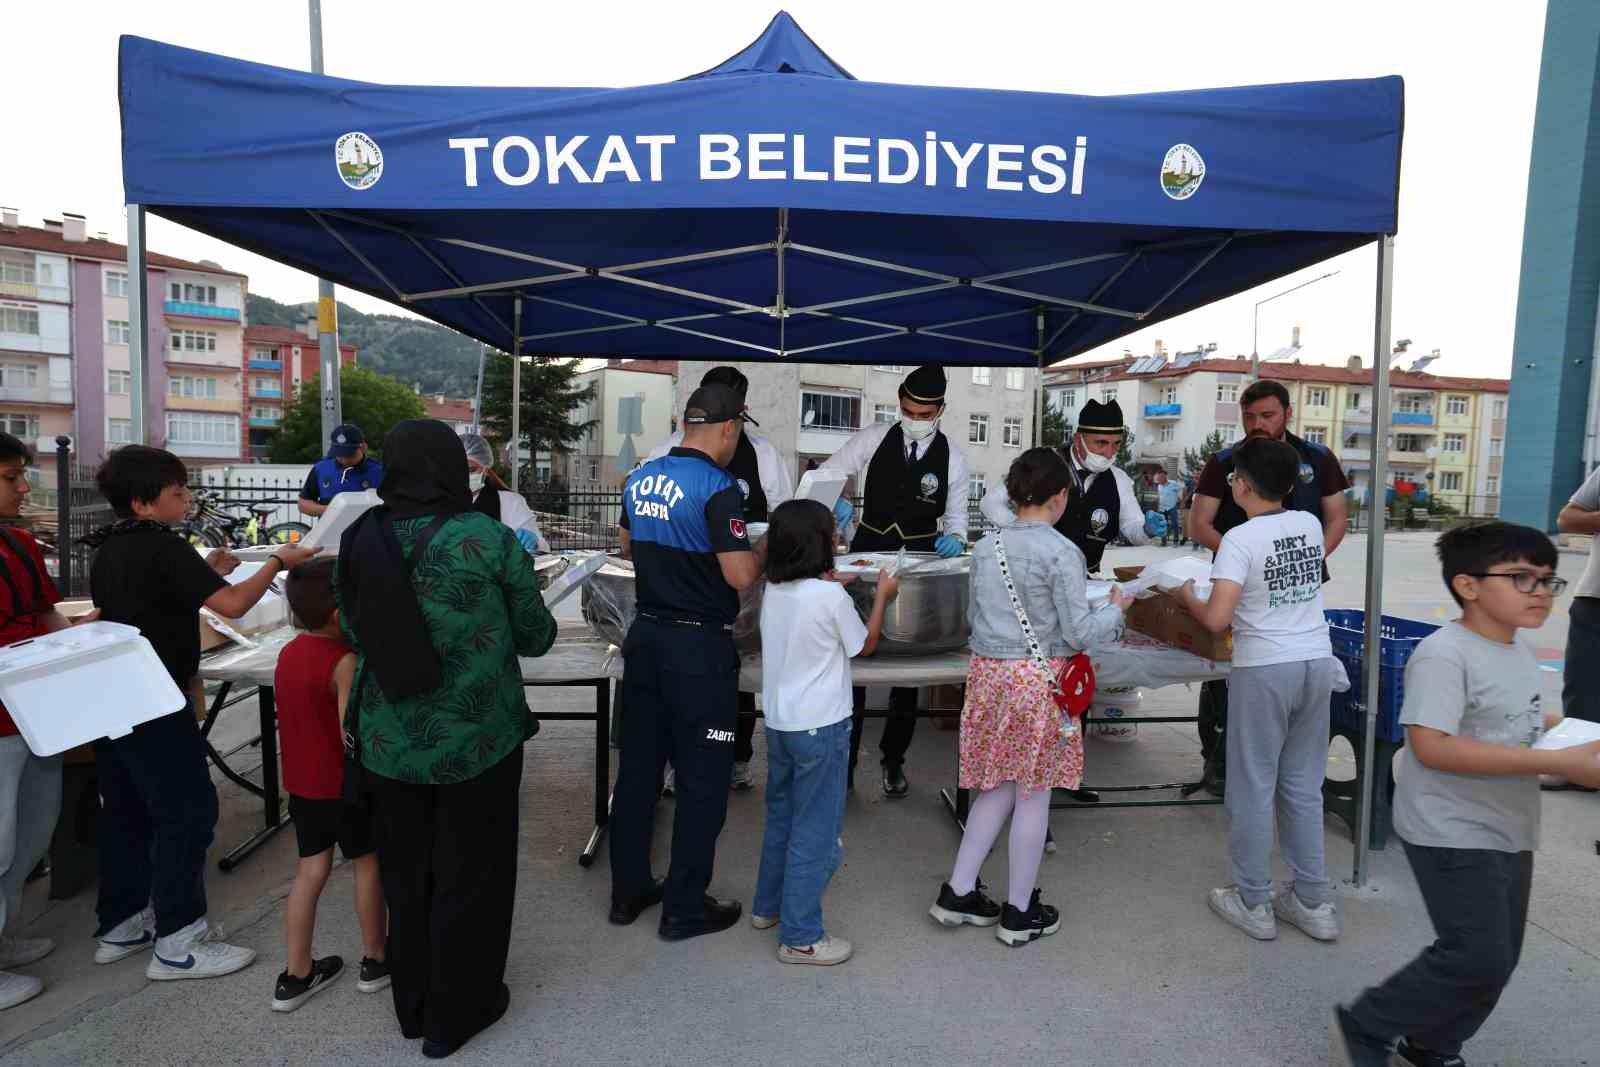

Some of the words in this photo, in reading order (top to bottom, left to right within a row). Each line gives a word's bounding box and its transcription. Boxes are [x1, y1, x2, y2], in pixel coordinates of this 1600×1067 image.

[449, 134, 676, 187] TOKAT
[699, 131, 1087, 195] BELEDİYESİ
[630, 474, 685, 508] TOKAT
